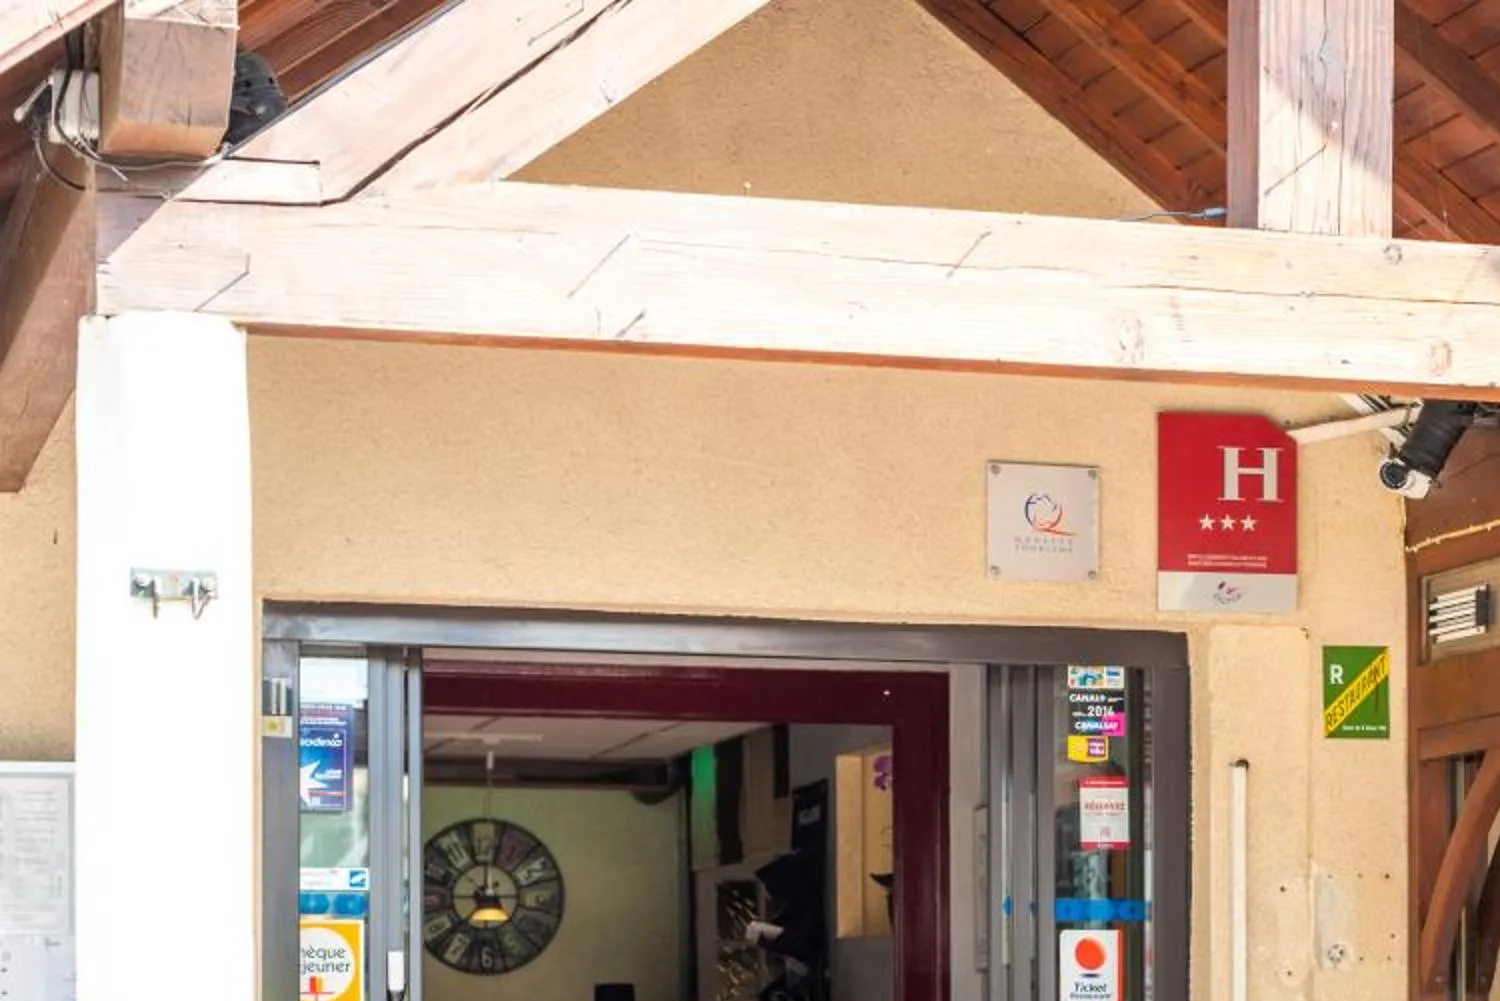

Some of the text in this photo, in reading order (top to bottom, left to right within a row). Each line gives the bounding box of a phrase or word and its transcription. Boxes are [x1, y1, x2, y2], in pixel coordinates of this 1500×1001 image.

[1216, 445, 1284, 503] H
[1329, 663, 1345, 685] R
[300, 944, 346, 961] èque
[300, 961, 351, 976] jeuner
[1074, 981, 1108, 993] Ticket
